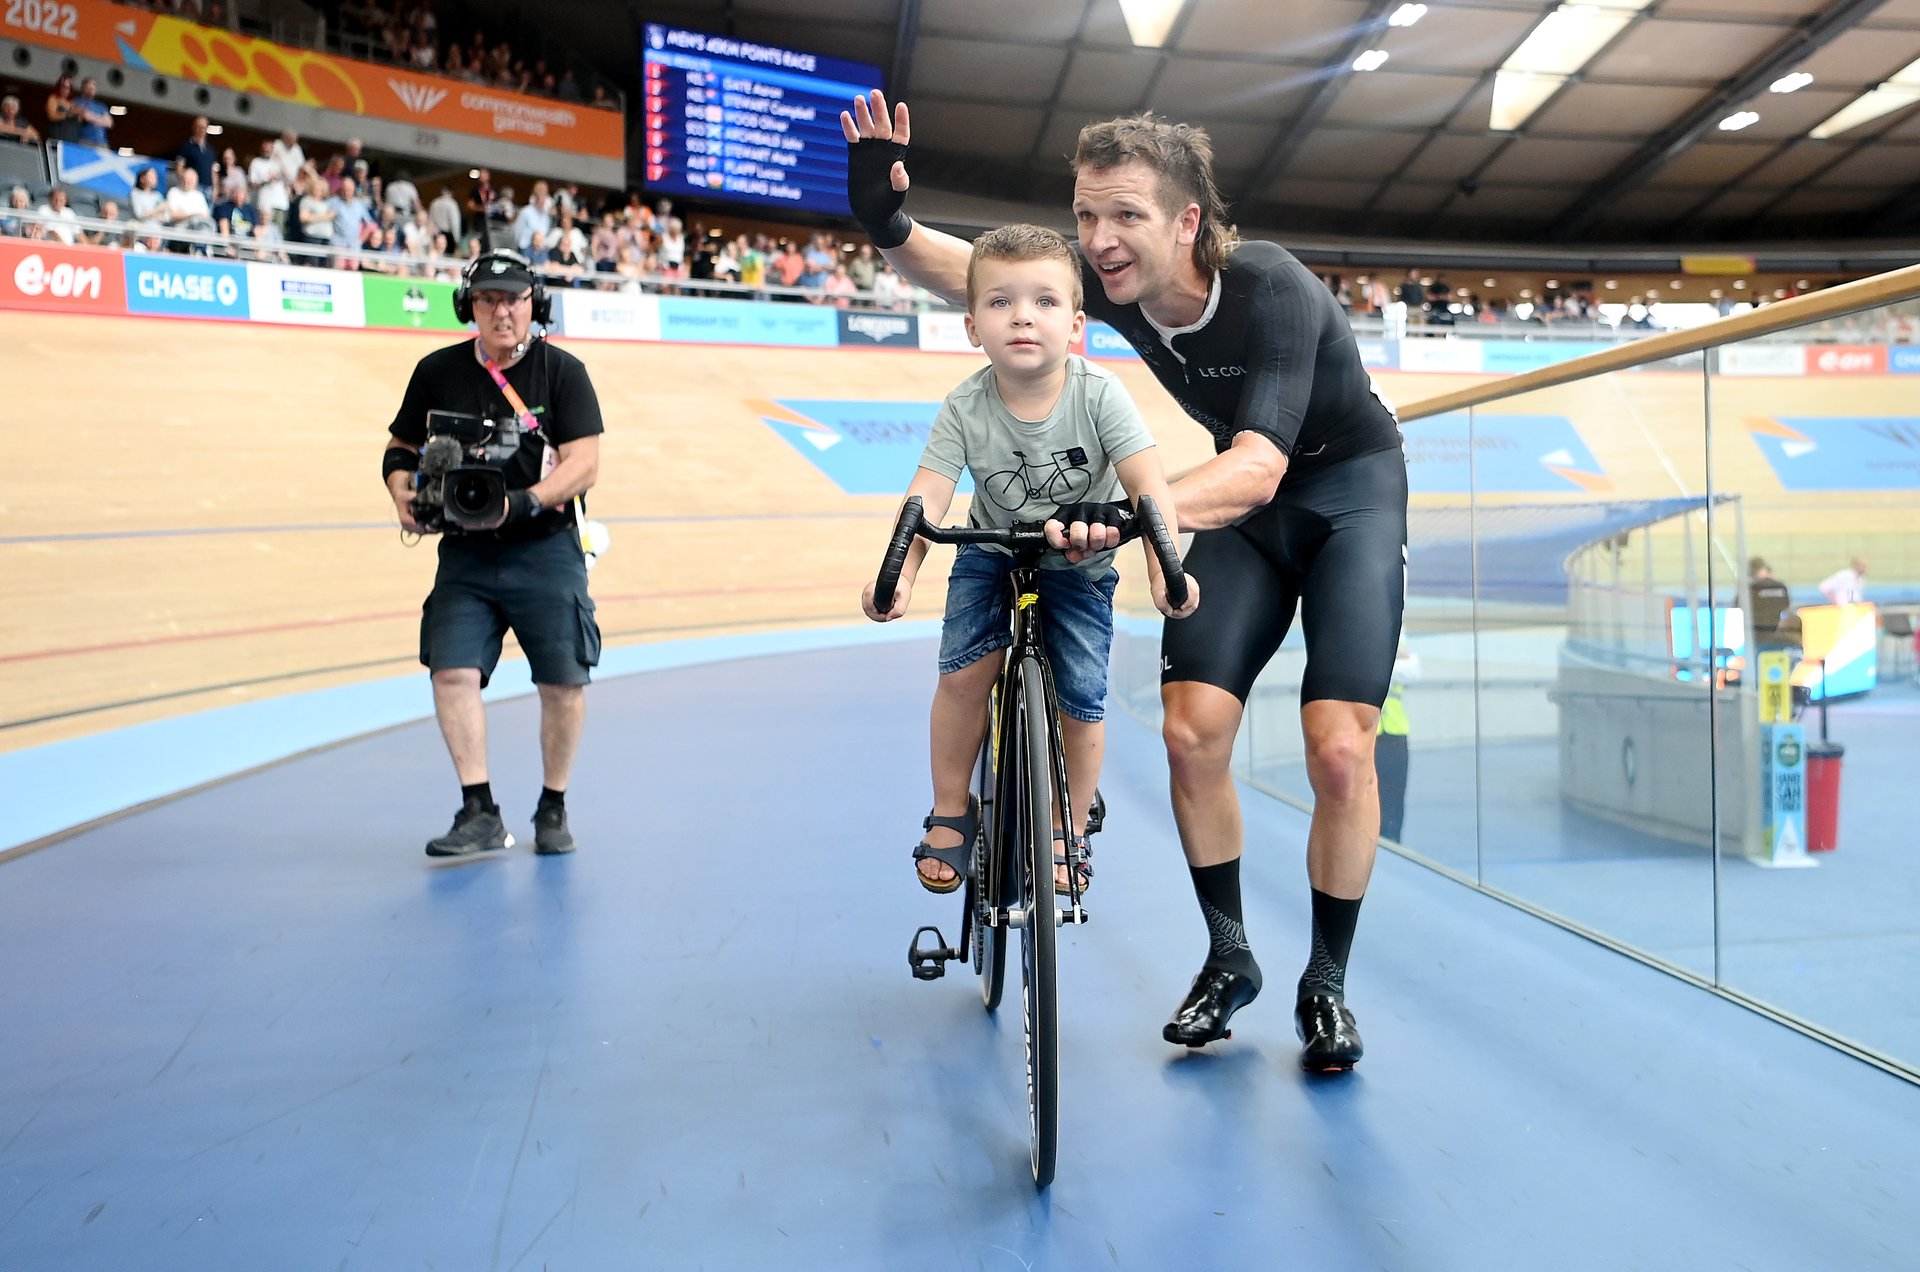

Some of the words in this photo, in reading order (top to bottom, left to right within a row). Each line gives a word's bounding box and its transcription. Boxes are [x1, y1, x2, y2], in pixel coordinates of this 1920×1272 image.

[5, 0, 78, 40] 2022
[461, 91, 576, 128] commonwealth
[493, 112, 546, 136] games
[138, 270, 215, 301] CHASE
[1198, 367, 1219, 378] LE
